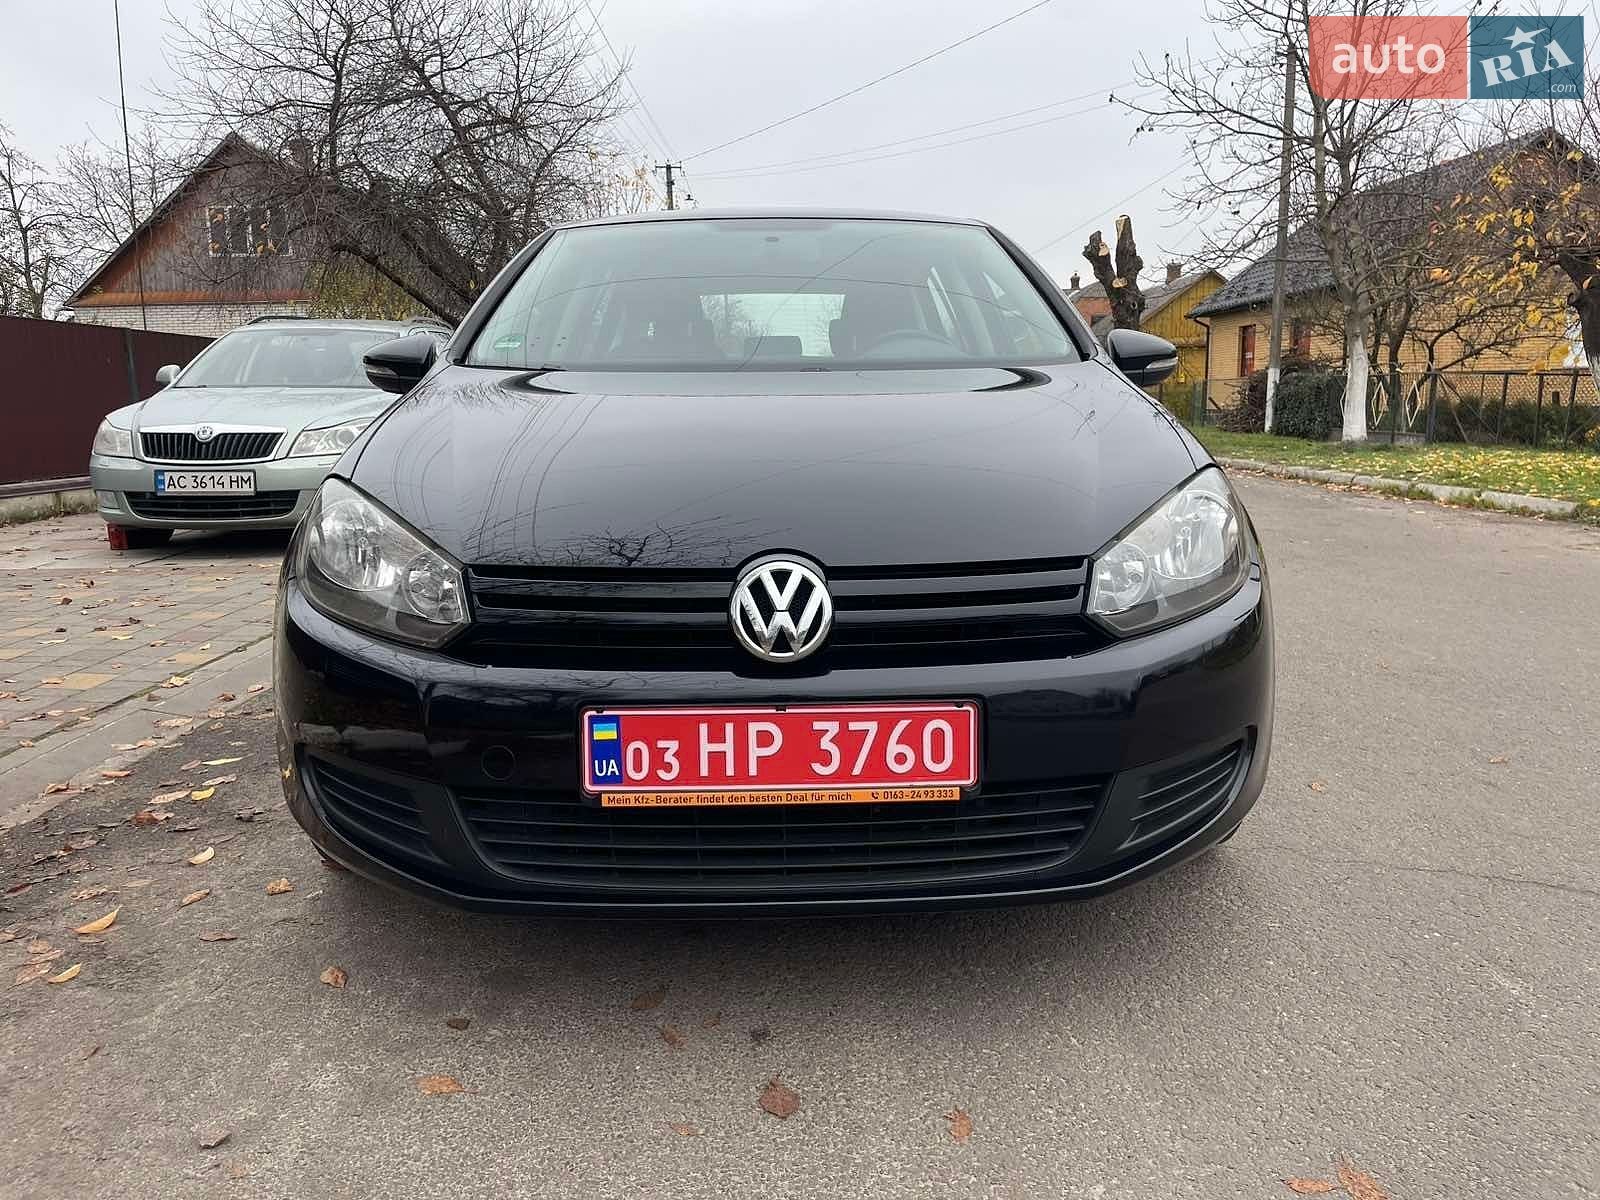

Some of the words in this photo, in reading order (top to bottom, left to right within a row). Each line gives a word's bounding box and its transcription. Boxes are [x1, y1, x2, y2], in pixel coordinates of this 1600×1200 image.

[166, 475, 188, 489] AC
[191, 475, 225, 489] 3614
[229, 475, 252, 489] HM
[625, 740, 681, 781] 03
[698, 721, 784, 777] HP
[809, 719, 955, 777] 3760
[594, 759, 620, 777] UA
[607, 795, 631, 805] Mein
[634, 795, 695, 804] Kfz-Berater
[696, 794, 725, 804] findet
[727, 794, 746, 803] den
[749, 793, 783, 802] besten
[785, 792, 808, 802] Deal
[811, 792, 825, 801] für
[828, 792, 852, 801] mich
